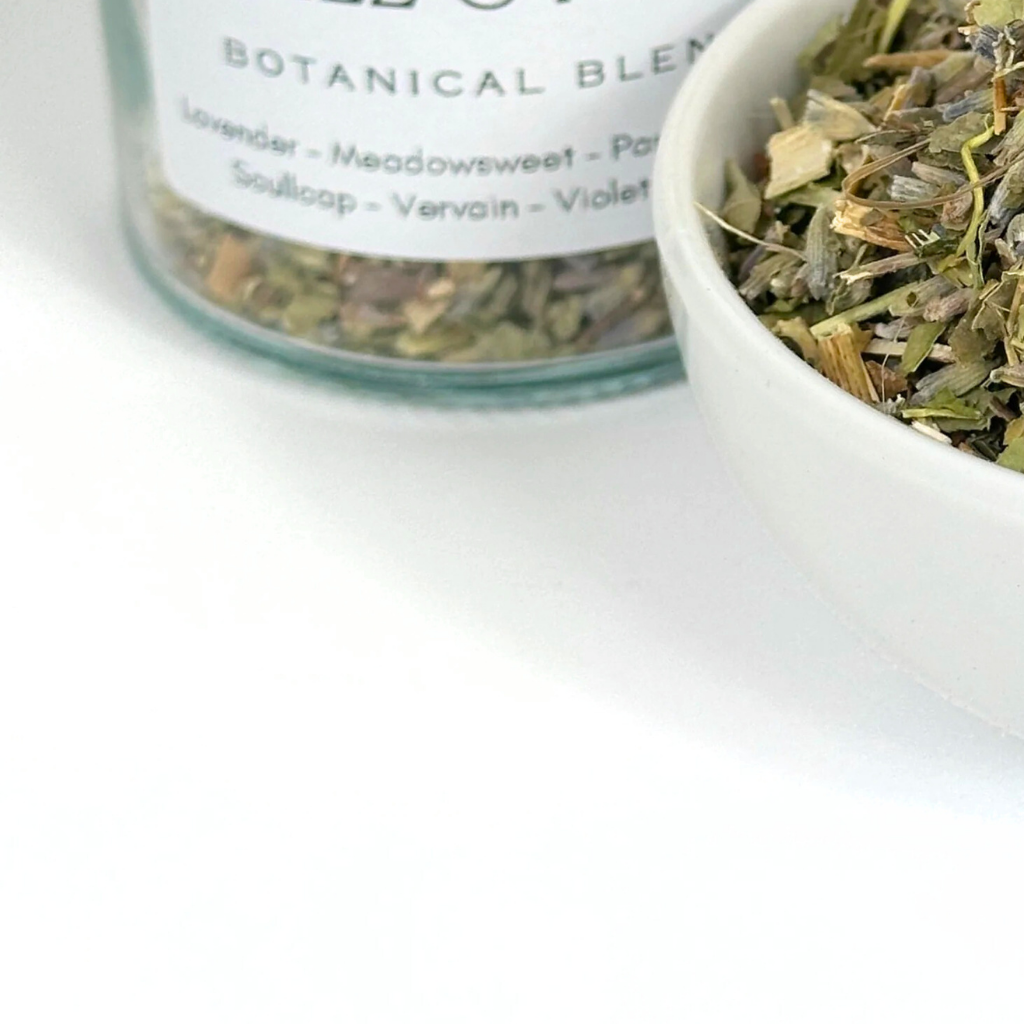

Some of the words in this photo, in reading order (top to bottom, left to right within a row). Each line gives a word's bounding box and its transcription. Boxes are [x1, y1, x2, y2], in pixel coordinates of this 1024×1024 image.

[223, 35, 546, 99] BOTANICAL
[576, 33, 715, 90] BLEN
[178, 94, 299, 158] Lavender
[330, 141, 575, 176] Meadowsweet
[390, 192, 520, 219] Vervain
[555, 178, 650, 212] Violet
